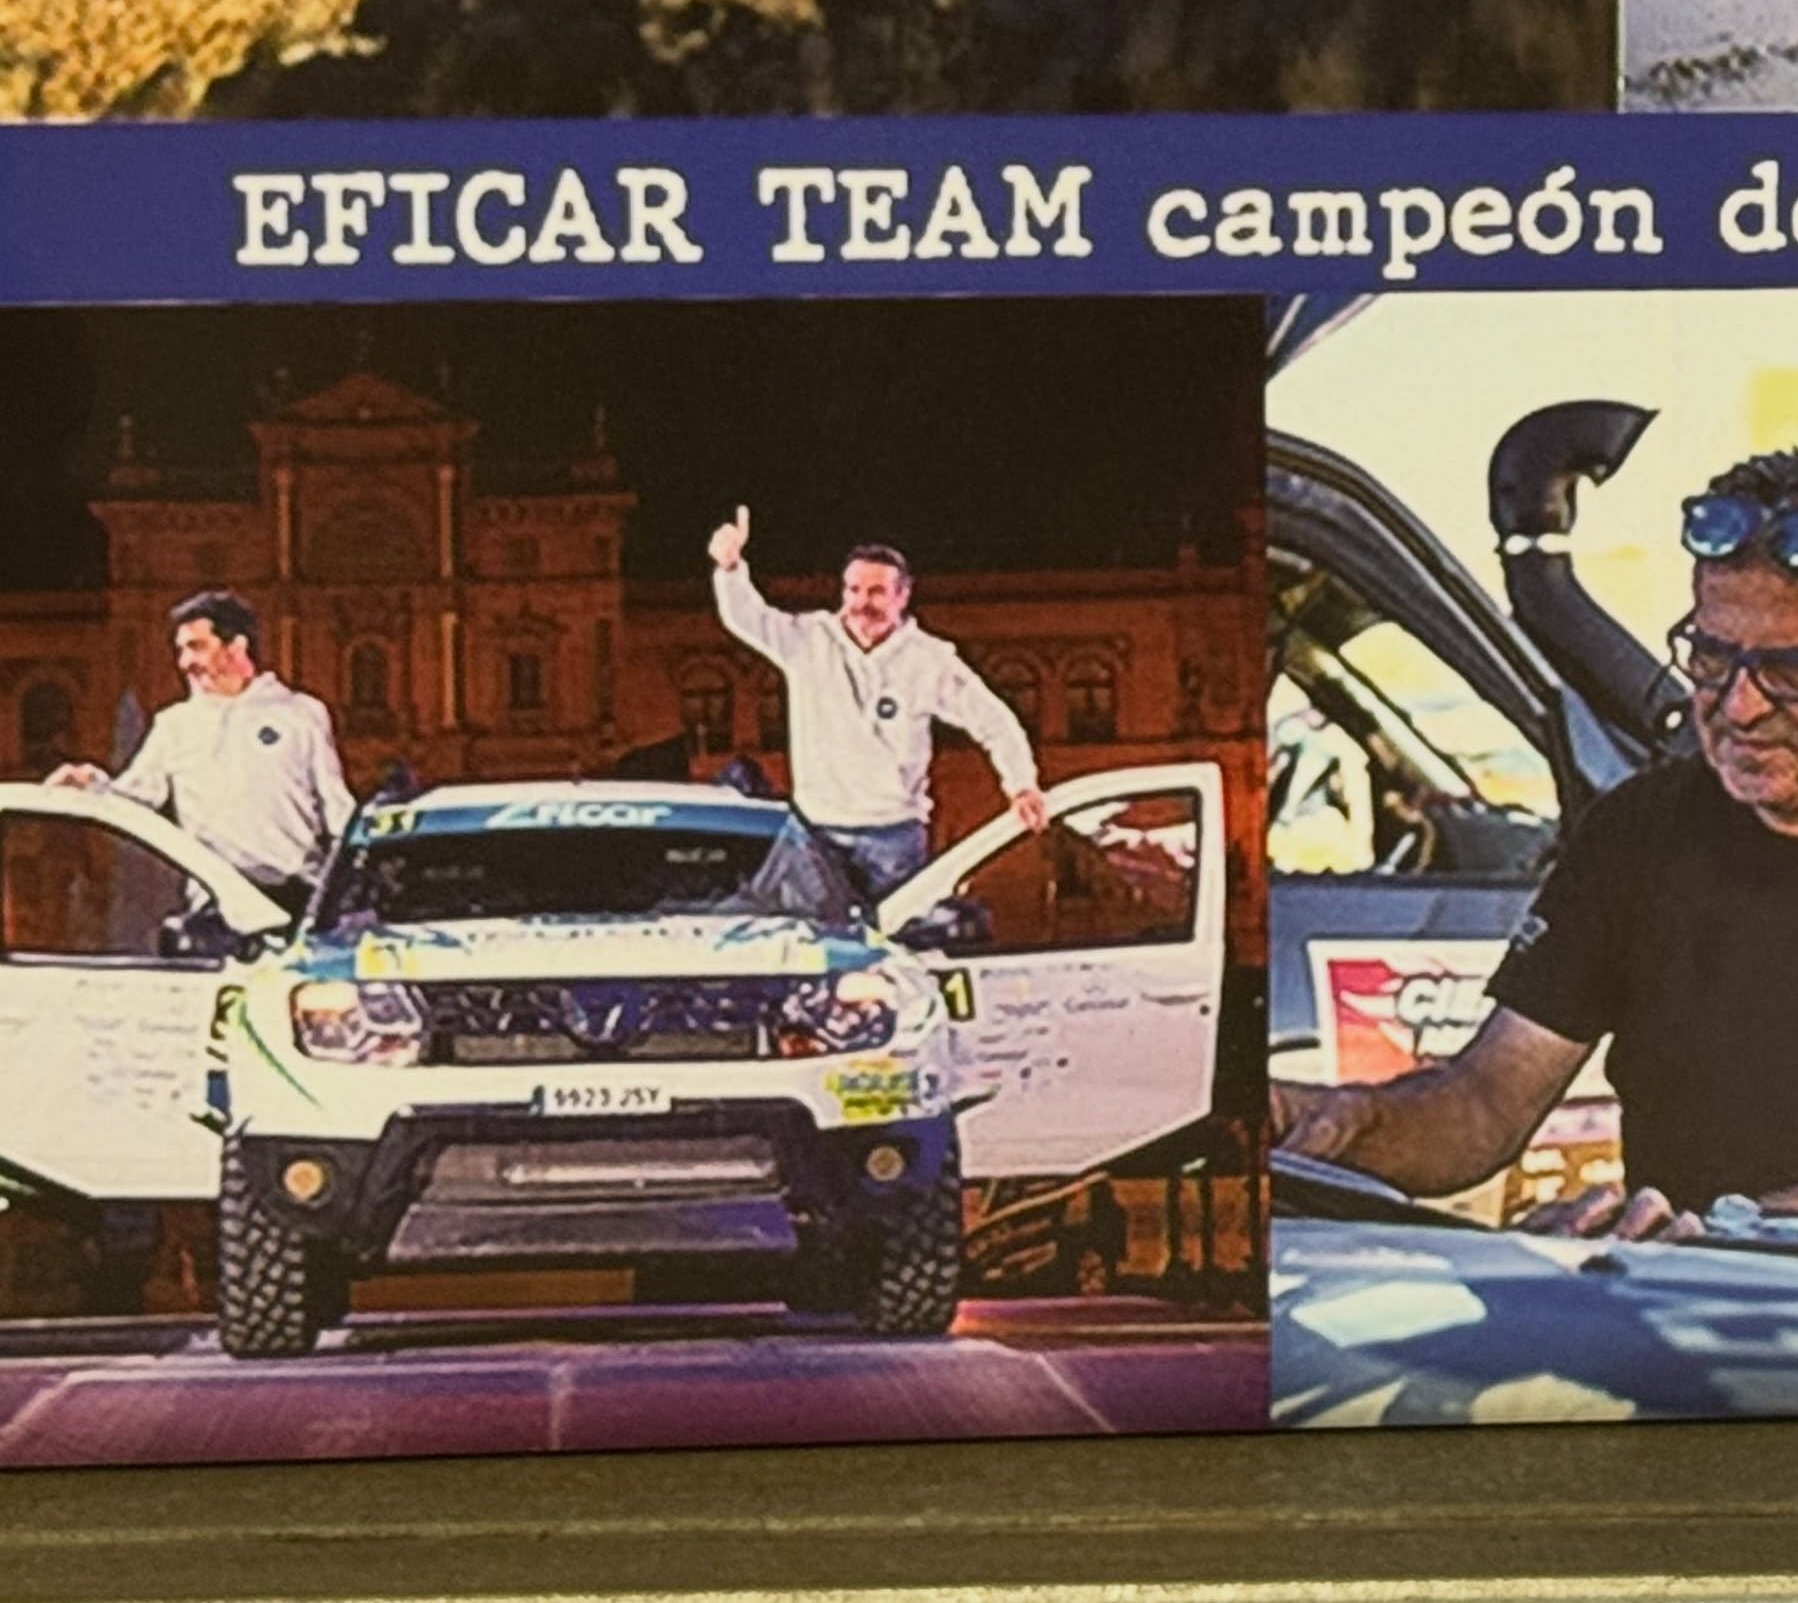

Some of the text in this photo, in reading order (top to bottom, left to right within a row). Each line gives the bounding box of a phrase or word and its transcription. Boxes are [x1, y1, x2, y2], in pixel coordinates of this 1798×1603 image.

[233, 168, 703, 266] EFICAR
[758, 165, 1092, 262] TEAM
[1147, 165, 1663, 280] campeón
